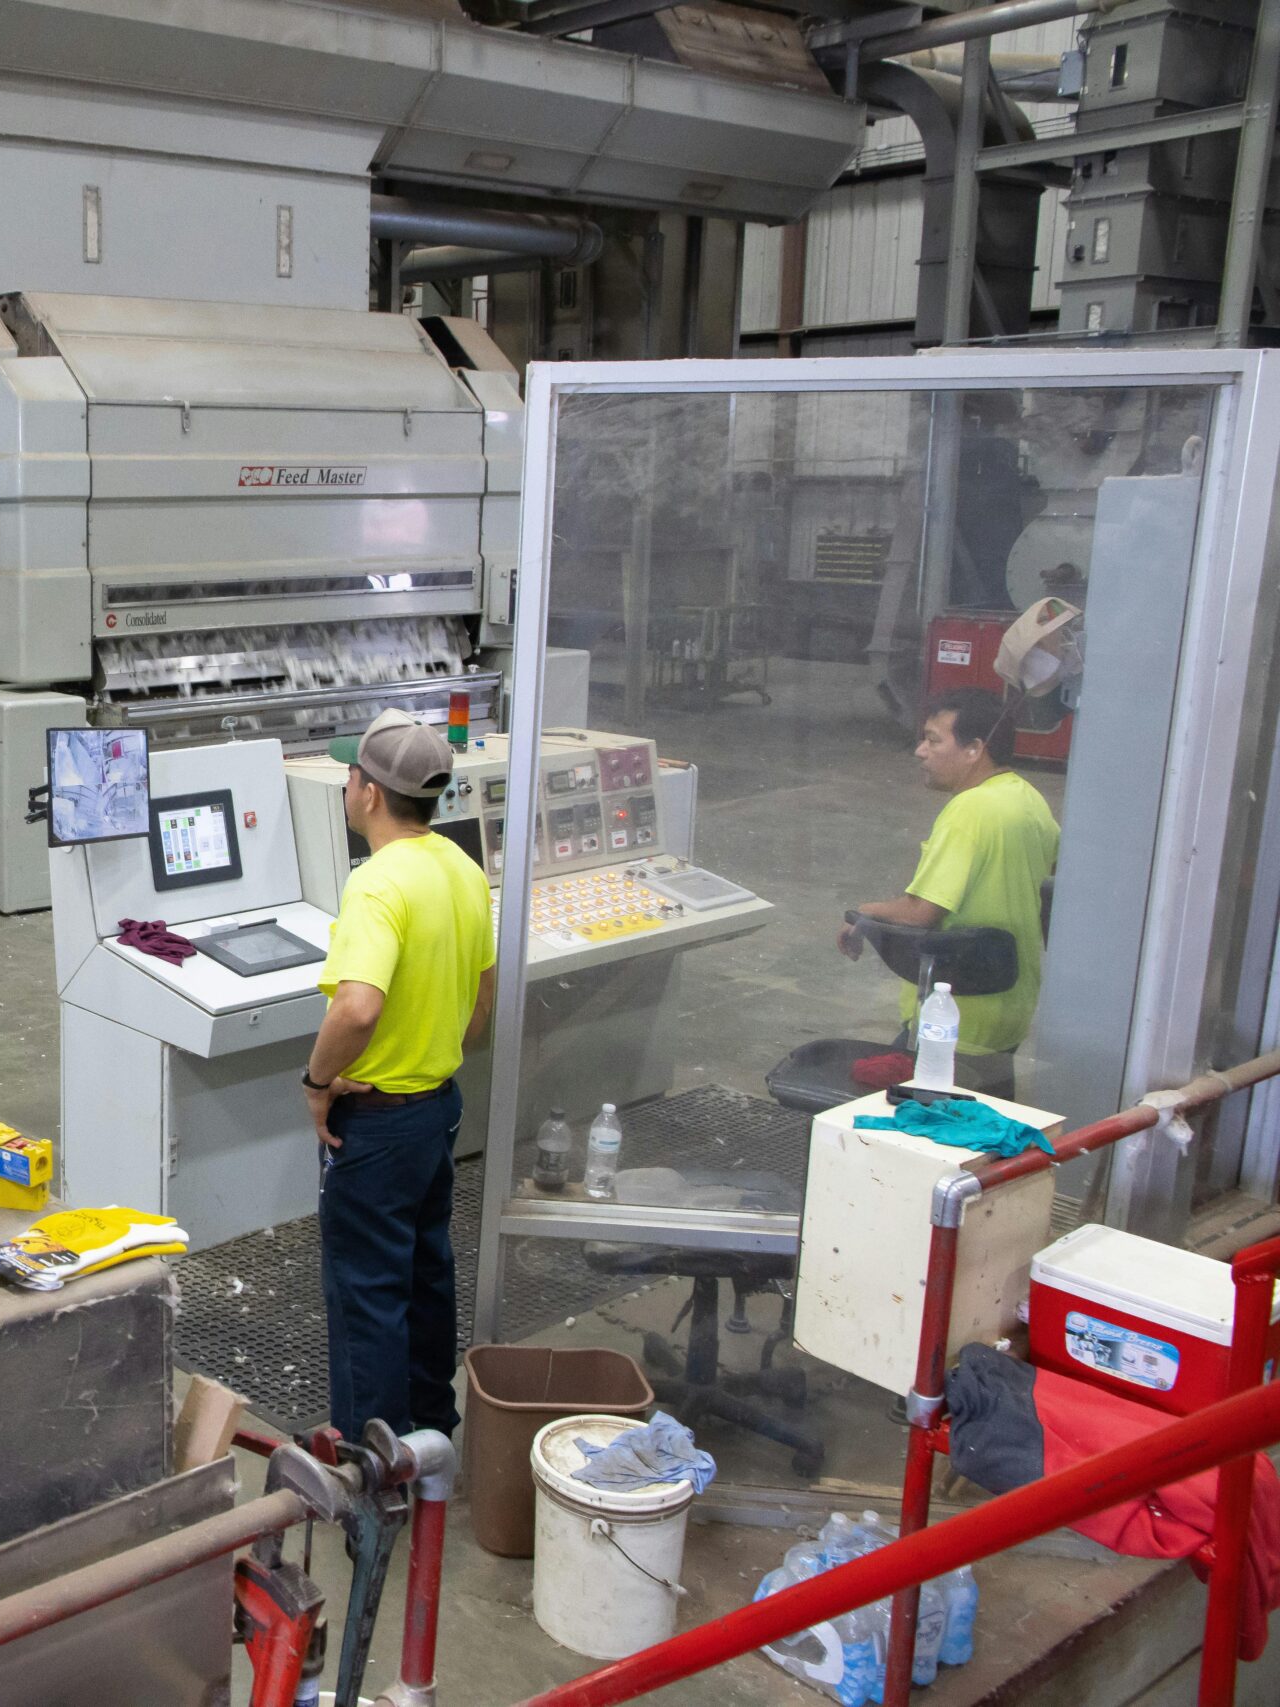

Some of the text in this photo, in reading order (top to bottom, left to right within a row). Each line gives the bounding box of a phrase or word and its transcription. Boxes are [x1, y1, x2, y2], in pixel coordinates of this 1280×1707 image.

[276, 468, 363, 484] Feed Master
[125, 611, 167, 627] Consolidated
